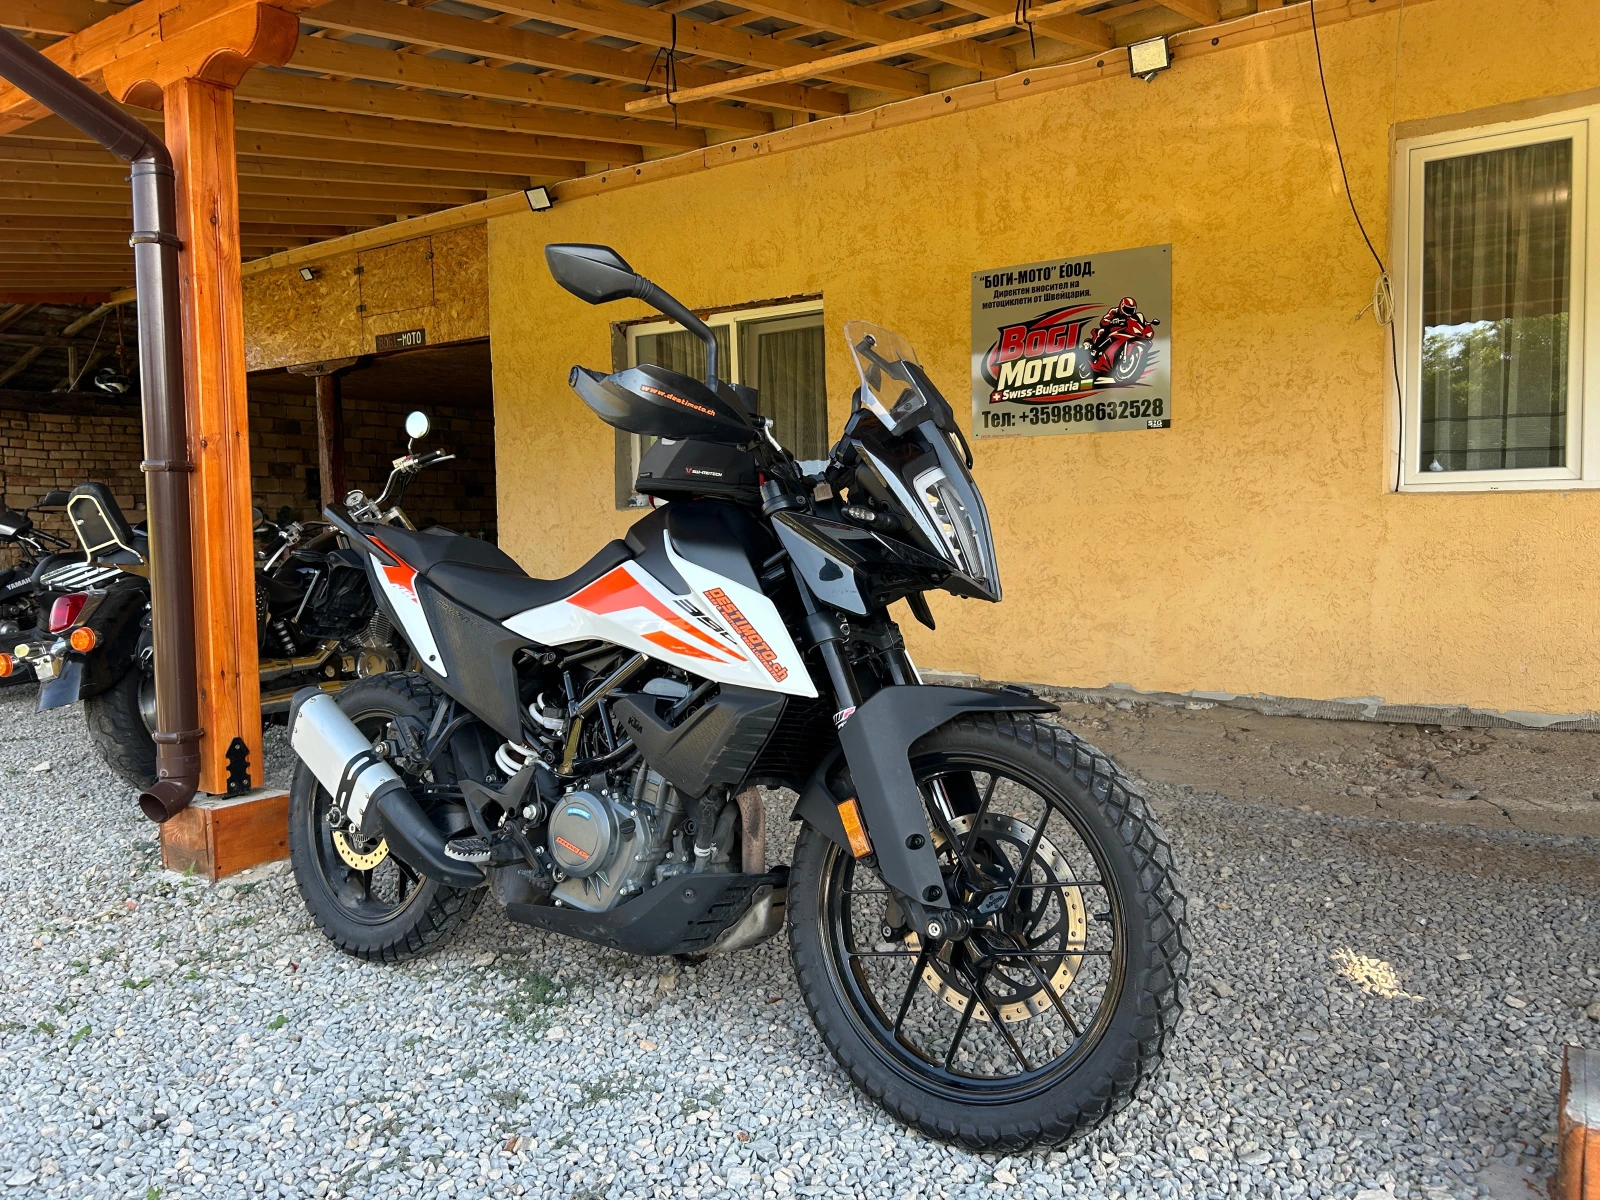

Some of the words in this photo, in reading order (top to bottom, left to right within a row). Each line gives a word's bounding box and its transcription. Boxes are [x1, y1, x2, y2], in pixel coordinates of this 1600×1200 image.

[982, 297, 1032, 309] мотоциклети
[1043, 289, 1091, 301] Швейцария.
[993, 288, 1029, 299] Директен
[1031, 282, 1068, 293] вносител
[1069, 280, 1080, 288] на
[1002, 381, 1079, 400] Swiss-Bulgaria
[641, 385, 716, 417] www.destimoto.ch
[982, 411, 1015, 428] Тел:
[1019, 399, 1163, 425] +359888632528
[6, 577, 32, 591] YAMAH
